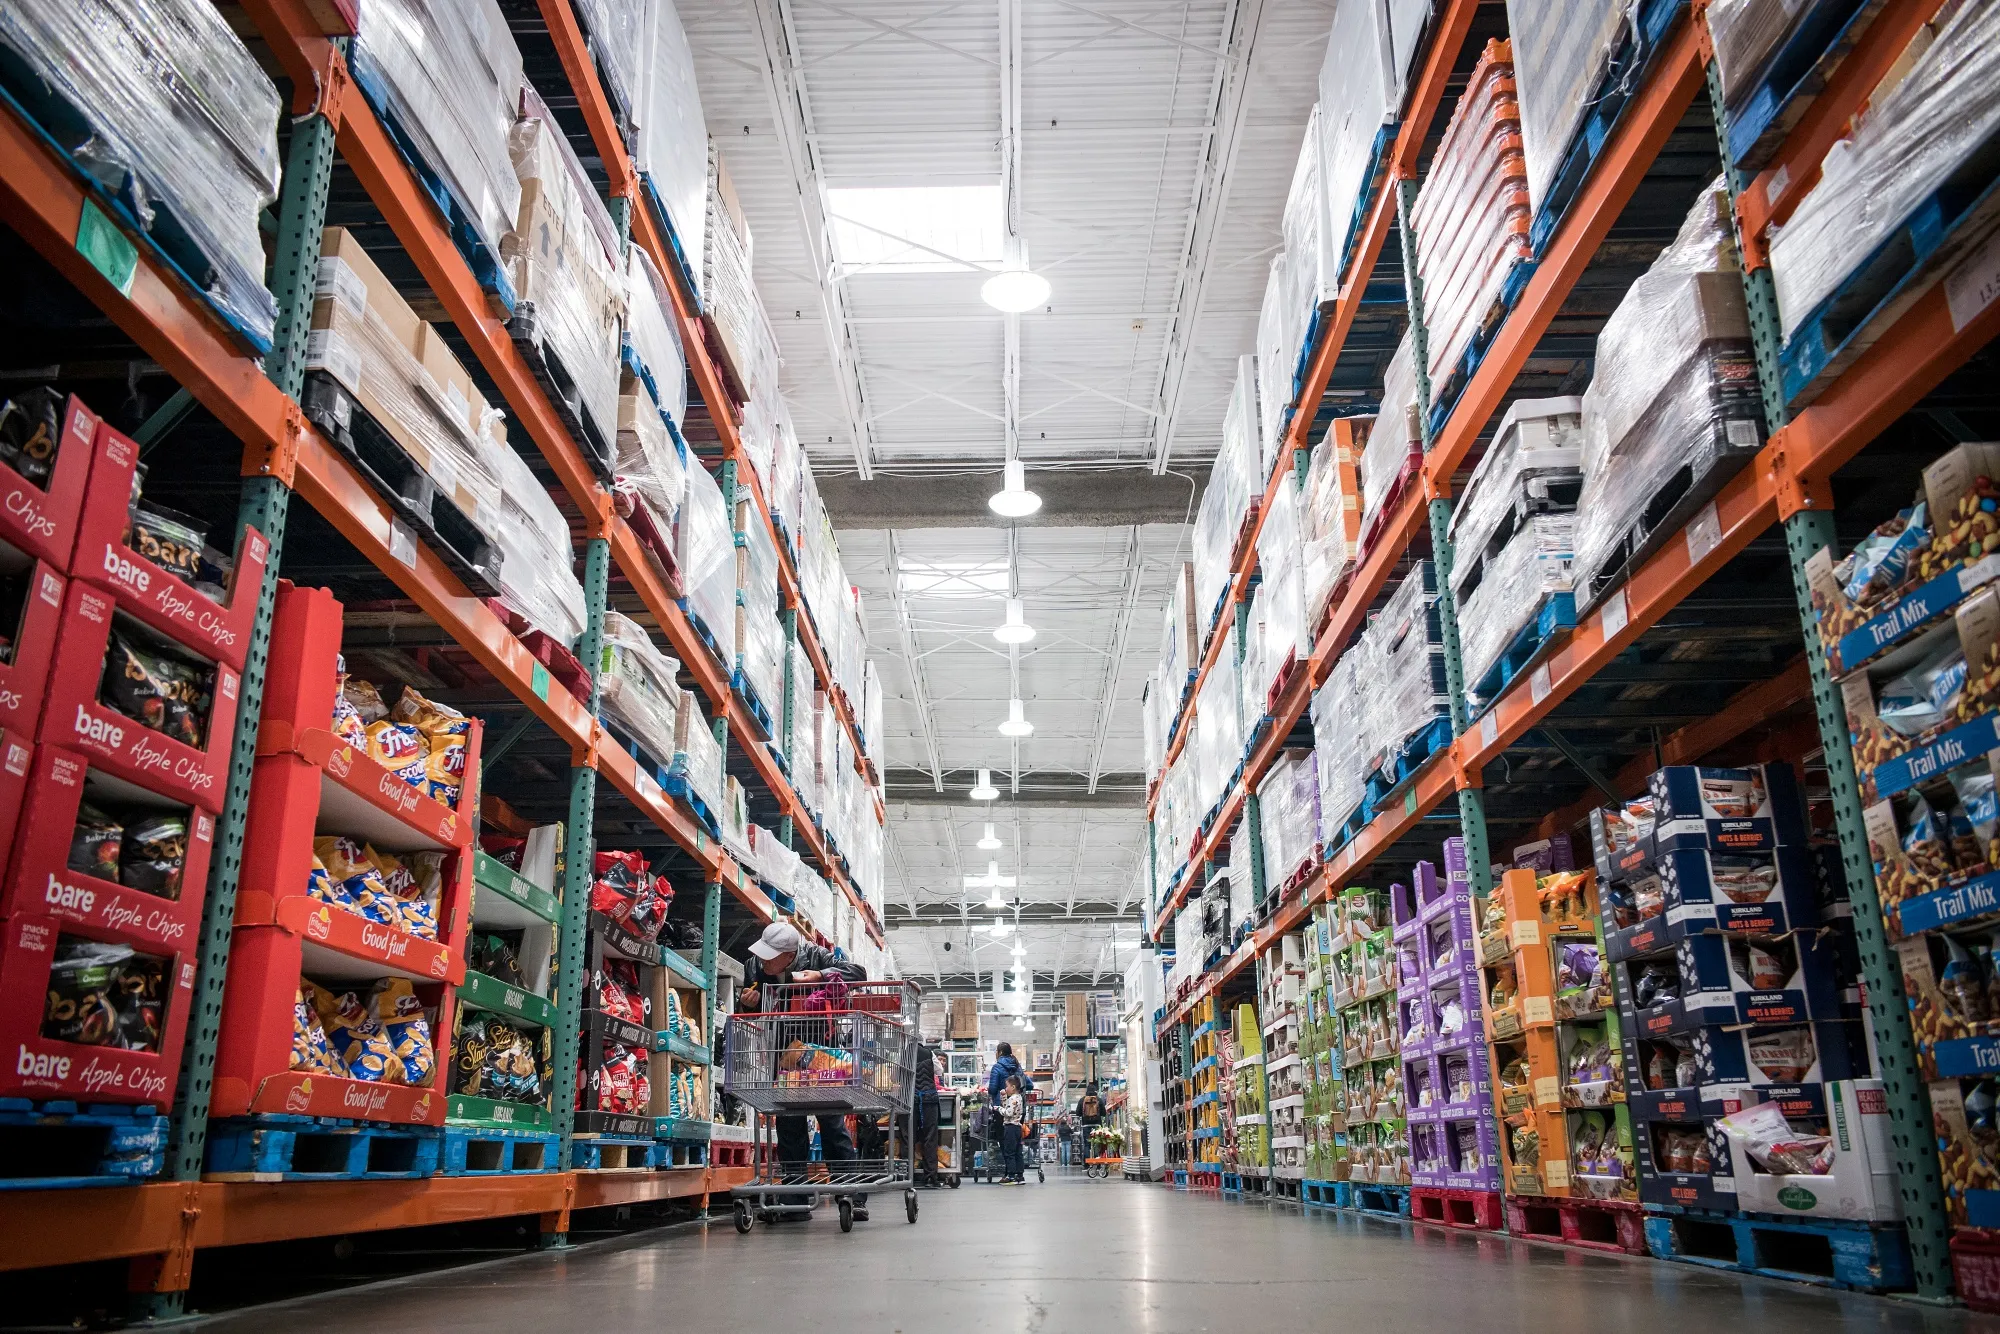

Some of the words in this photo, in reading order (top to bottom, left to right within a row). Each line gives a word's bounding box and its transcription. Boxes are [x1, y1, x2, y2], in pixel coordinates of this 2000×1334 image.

[106, 450, 130, 468] simple
[109, 436, 131, 455] snacks
[6, 490, 57, 537] Chips
[104, 543, 150, 592] bare
[79, 607, 104, 624] simple
[82, 593, 106, 610] snacks
[156, 584, 195, 623] Apple
[198, 611, 236, 647] Chips
[1869, 612, 1901, 645] Trail
[1900, 598, 1930, 628] Mix
[75, 704, 124, 748] bare
[54, 757, 79, 773] snacks
[130, 736, 171, 771] Apple
[175, 757, 213, 791] Chips
[1905, 750, 1937, 780] Trail
[1936, 738, 1966, 767] Mix
[51, 772, 76, 788] simple
[379, 772, 404, 800] Good
[397, 788, 420, 813] fun!
[1718, 834, 1733, 843] NUTS
[1740, 833, 1764, 842] BERRIES
[45, 873, 95, 913] bare
[1933, 892, 1965, 920] Trail
[1967, 884, 1997, 909] Mix
[22, 923, 49, 936] snacks
[102, 895, 143, 928] Apple
[147, 912, 186, 942] Chips
[1728, 920, 1743, 928] NUTS
[1750, 918, 1775, 927] BERRIES
[19, 940, 47, 952] simple
[362, 924, 390, 951] Good
[385, 934, 409, 960] fun!
[1747, 1009, 1762, 1017] NUTS
[1764, 1008, 1769, 1016] &
[1771, 1007, 1795, 1016] BERRIES
[17, 1043, 71, 1080] bare
[79, 1056, 124, 1092] Apple
[129, 1060, 167, 1098] Chips
[344, 1084, 368, 1107] Good
[365, 1089, 389, 1116] fun!
[1788, 1101, 1814, 1110] BERRIES
[1835, 1102, 1850, 1150] WHOLESOME
